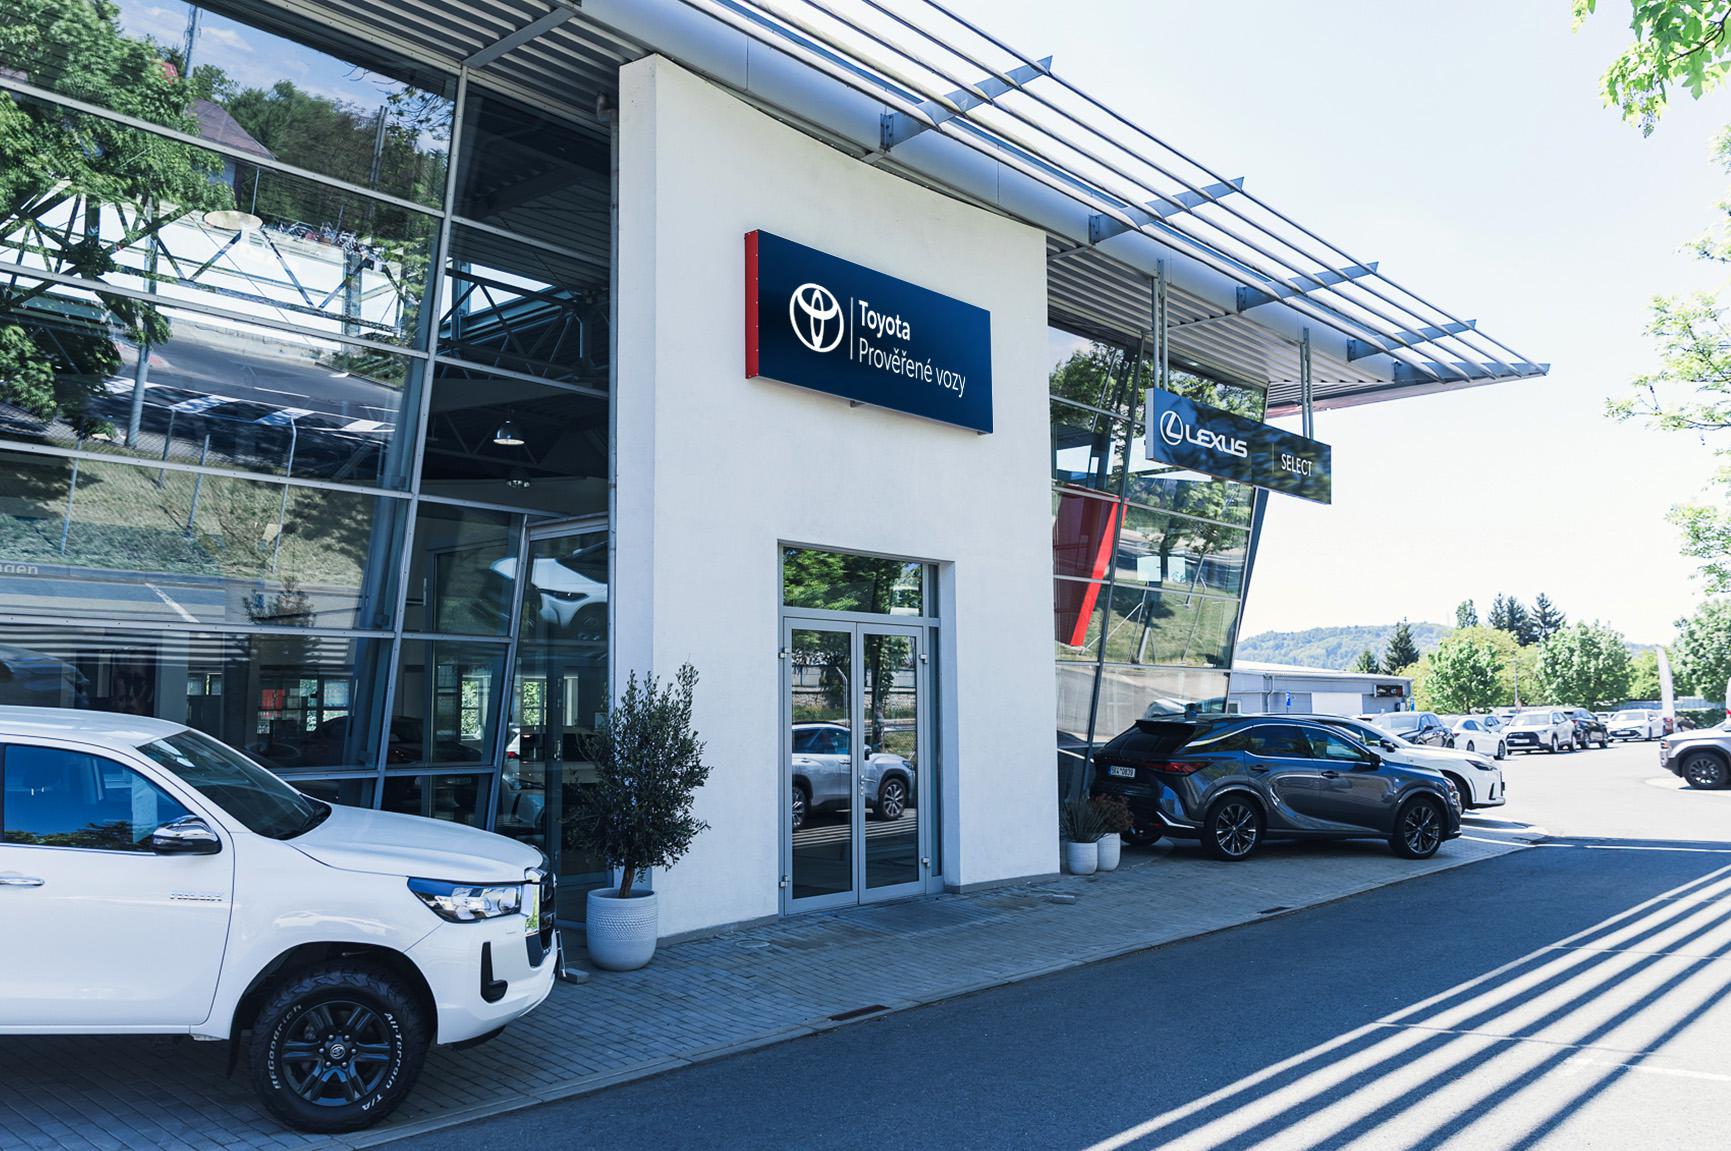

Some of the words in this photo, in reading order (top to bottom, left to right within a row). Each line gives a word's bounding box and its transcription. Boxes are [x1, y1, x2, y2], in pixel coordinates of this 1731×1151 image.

[859, 300, 910, 340] Toyota
[860, 338, 932, 382] Prověřené
[936, 367, 965, 398] vozy
[1186, 424, 1248, 458] LEXUS
[1281, 453, 1312, 477] SELECT
